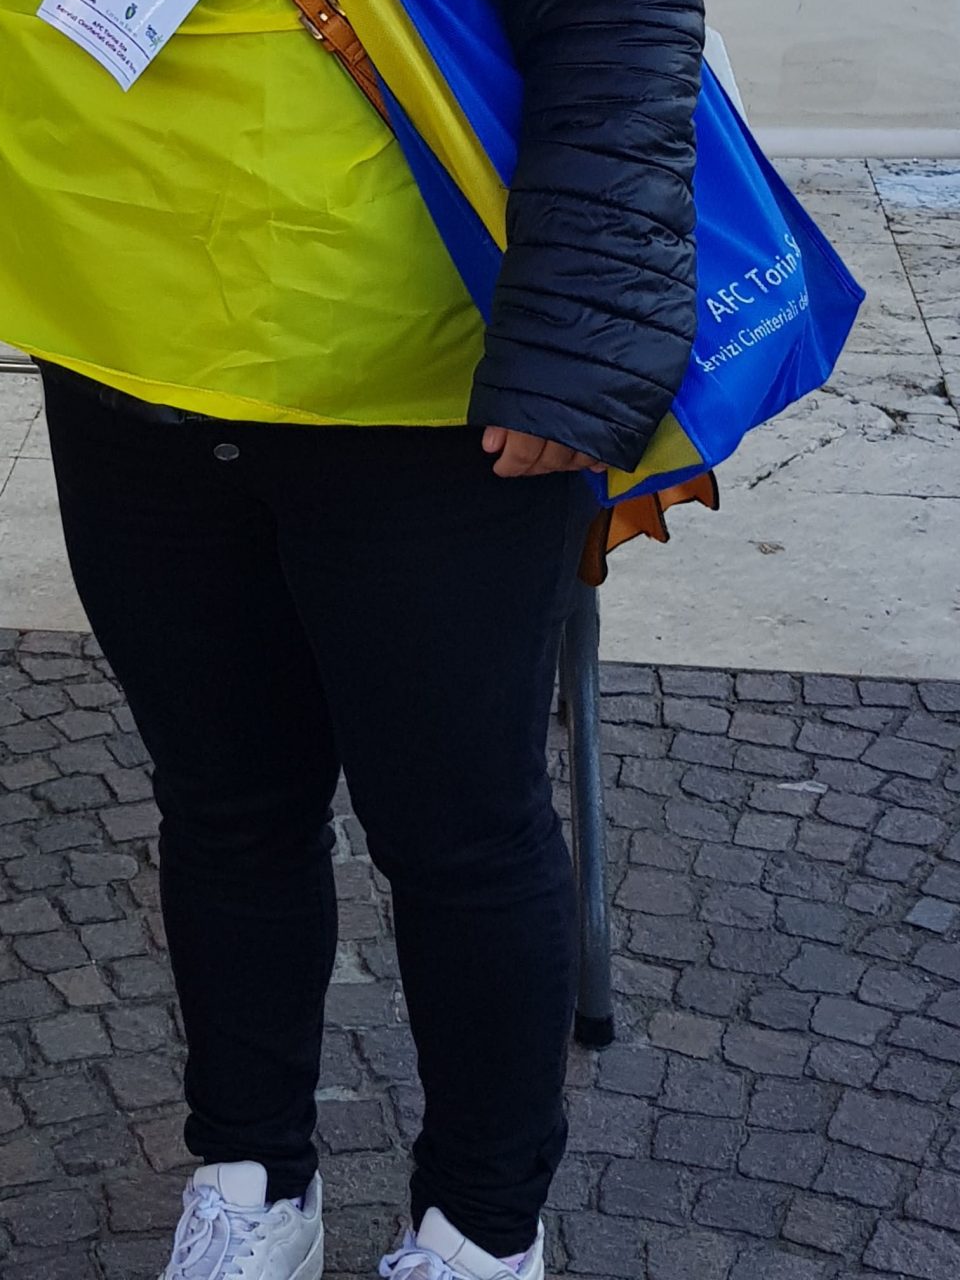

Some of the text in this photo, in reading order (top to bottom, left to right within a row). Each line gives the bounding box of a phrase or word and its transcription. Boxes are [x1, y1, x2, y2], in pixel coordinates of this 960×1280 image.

[706, 281, 755, 323] AFC
[744, 253, 797, 293] Torin
[738, 297, 799, 347] Cimiteriali
